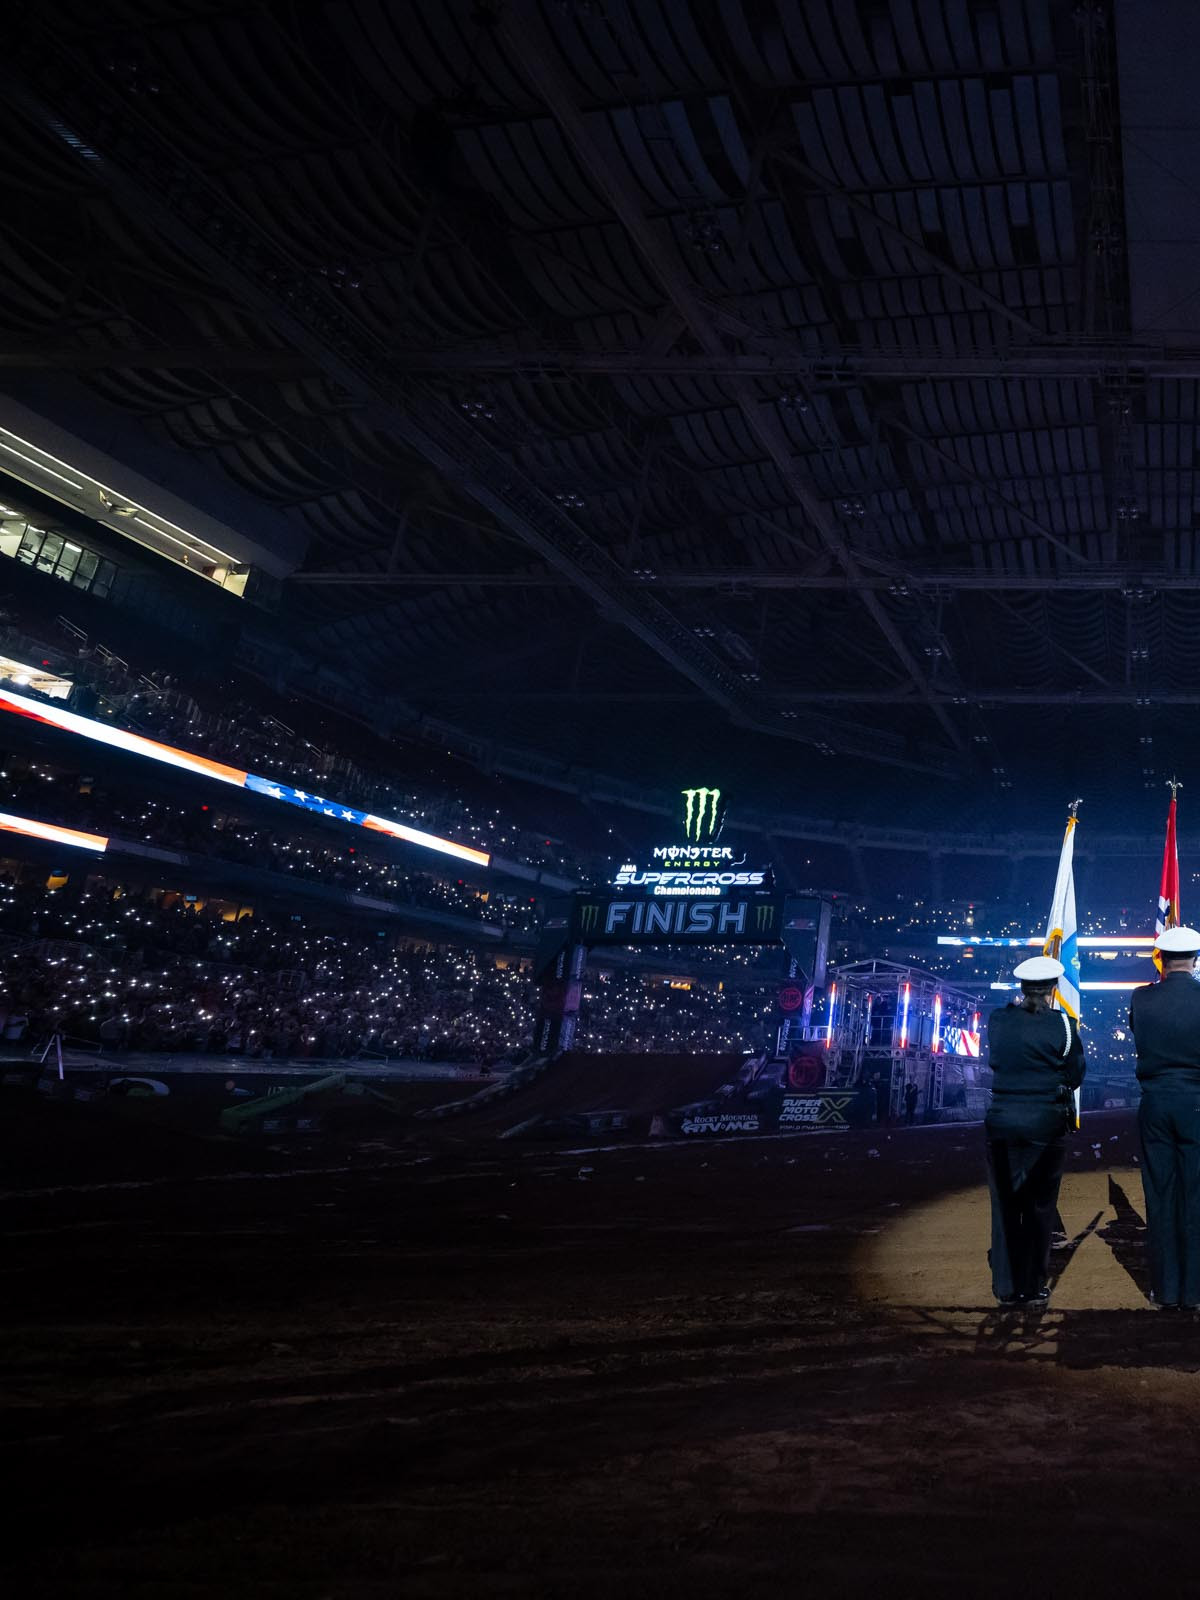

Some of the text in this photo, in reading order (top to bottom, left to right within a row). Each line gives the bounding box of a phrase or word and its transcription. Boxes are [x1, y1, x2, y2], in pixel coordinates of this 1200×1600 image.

[653, 845, 733, 859] MONSTER
[613, 872, 766, 885] SUPERCROSS
[653, 885, 721, 896] Championship
[604, 901, 748, 934] FINISH
[782, 1098, 822, 1106] SUPER
[779, 1114, 819, 1122] CROSS
